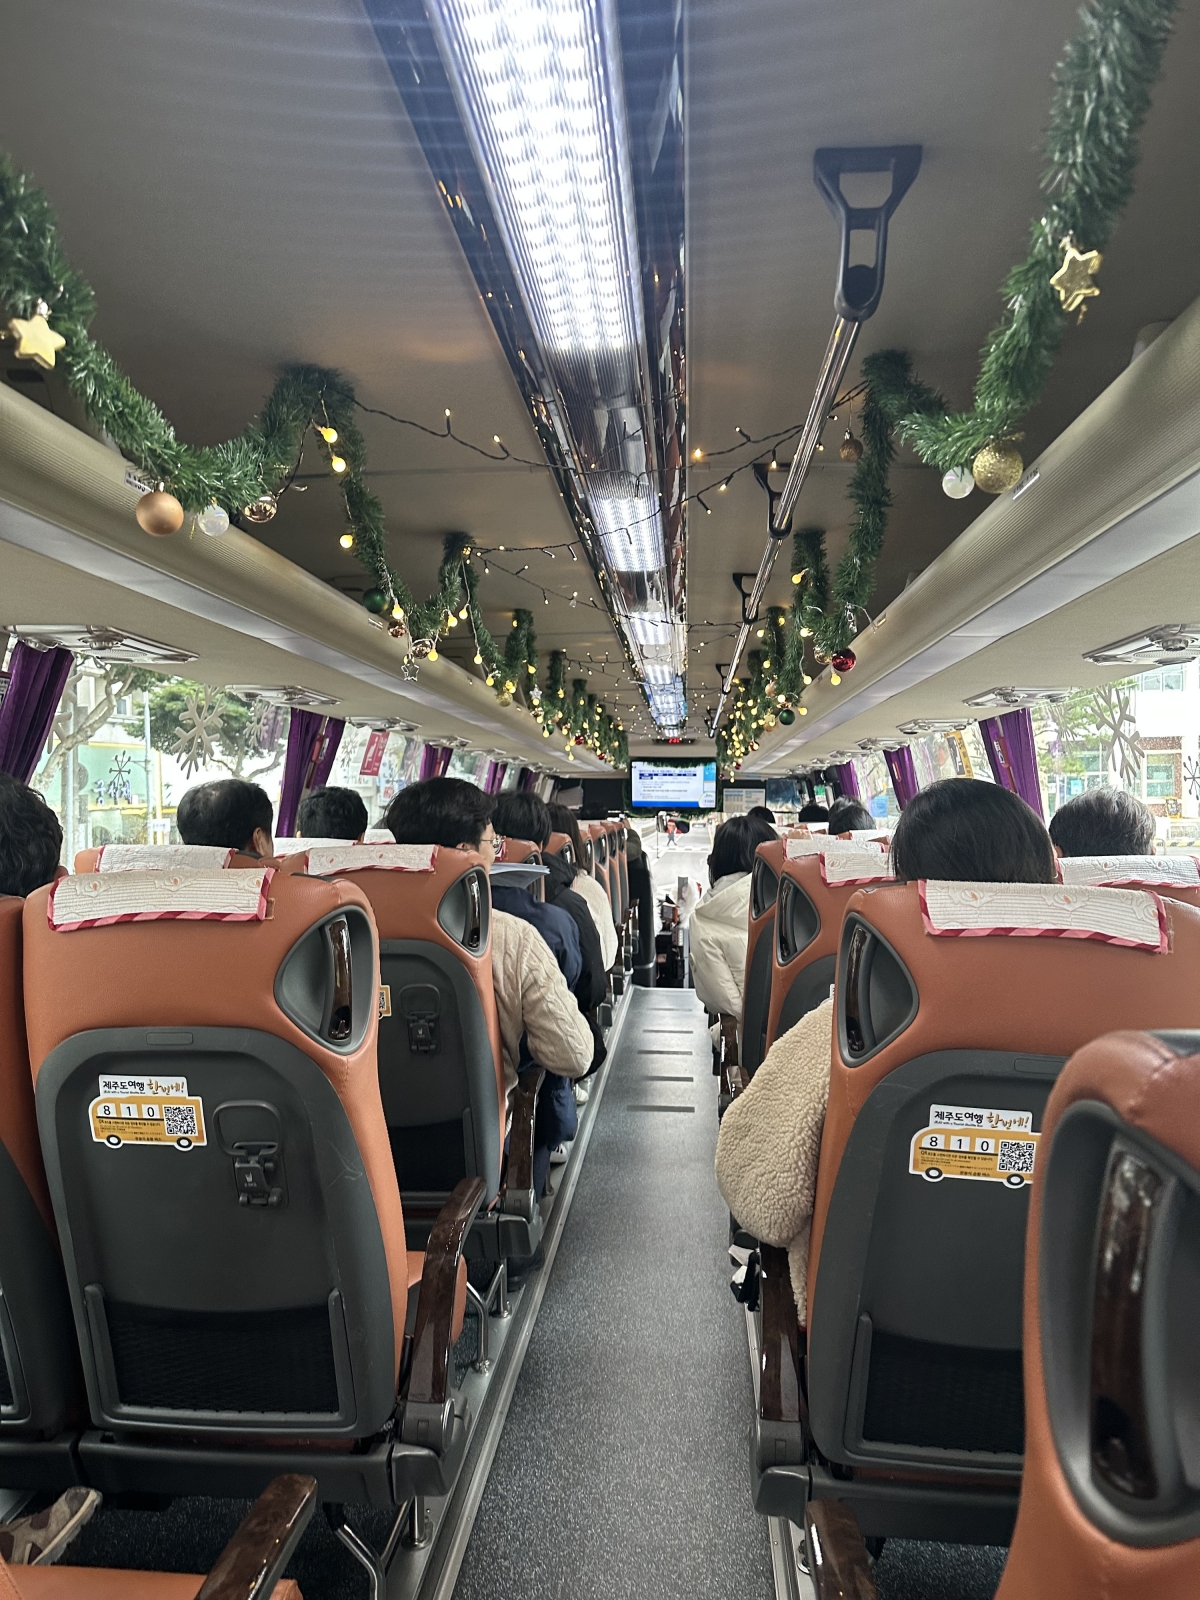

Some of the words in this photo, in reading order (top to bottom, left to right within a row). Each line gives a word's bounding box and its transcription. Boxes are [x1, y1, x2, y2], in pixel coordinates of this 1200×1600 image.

[102, 1080, 145, 1092] 제주도여행
[103, 1105, 111, 1116] 8
[126, 1106, 132, 1117] 1
[147, 1107, 155, 1118] 0
[934, 1110, 984, 1125] 제주도여행
[929, 1136, 938, 1147] 8
[957, 1138, 963, 1150] 1
[980, 1140, 990, 1152] 0
